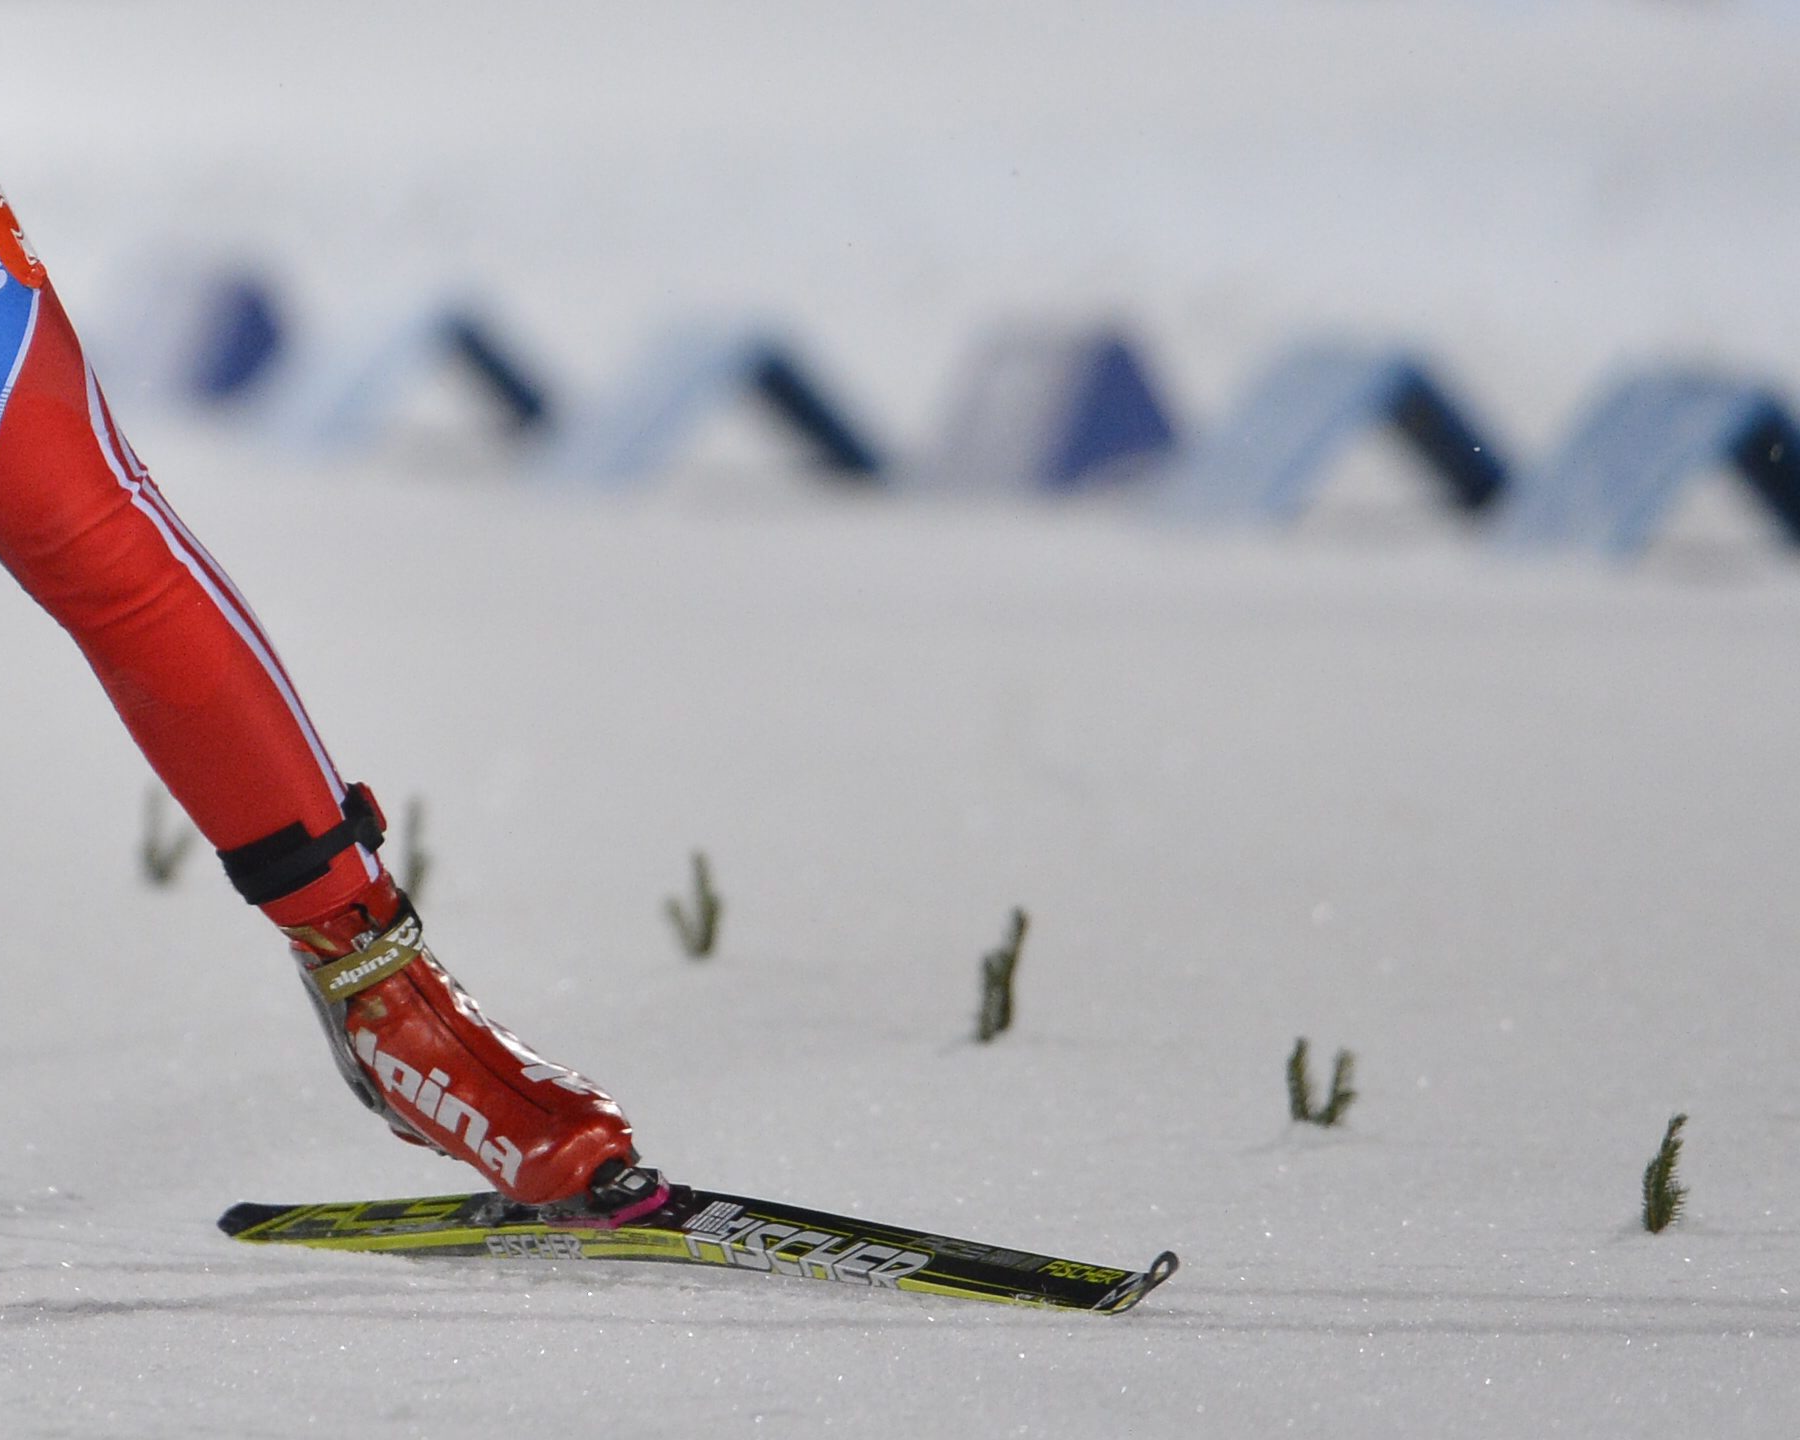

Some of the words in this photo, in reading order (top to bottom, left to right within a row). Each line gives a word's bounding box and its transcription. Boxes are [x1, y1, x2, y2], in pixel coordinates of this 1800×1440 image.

[329, 947, 400, 991] alpina
[485, 1233, 588, 1260] FISCHER
[1036, 1259, 1126, 1286] FISCHER
